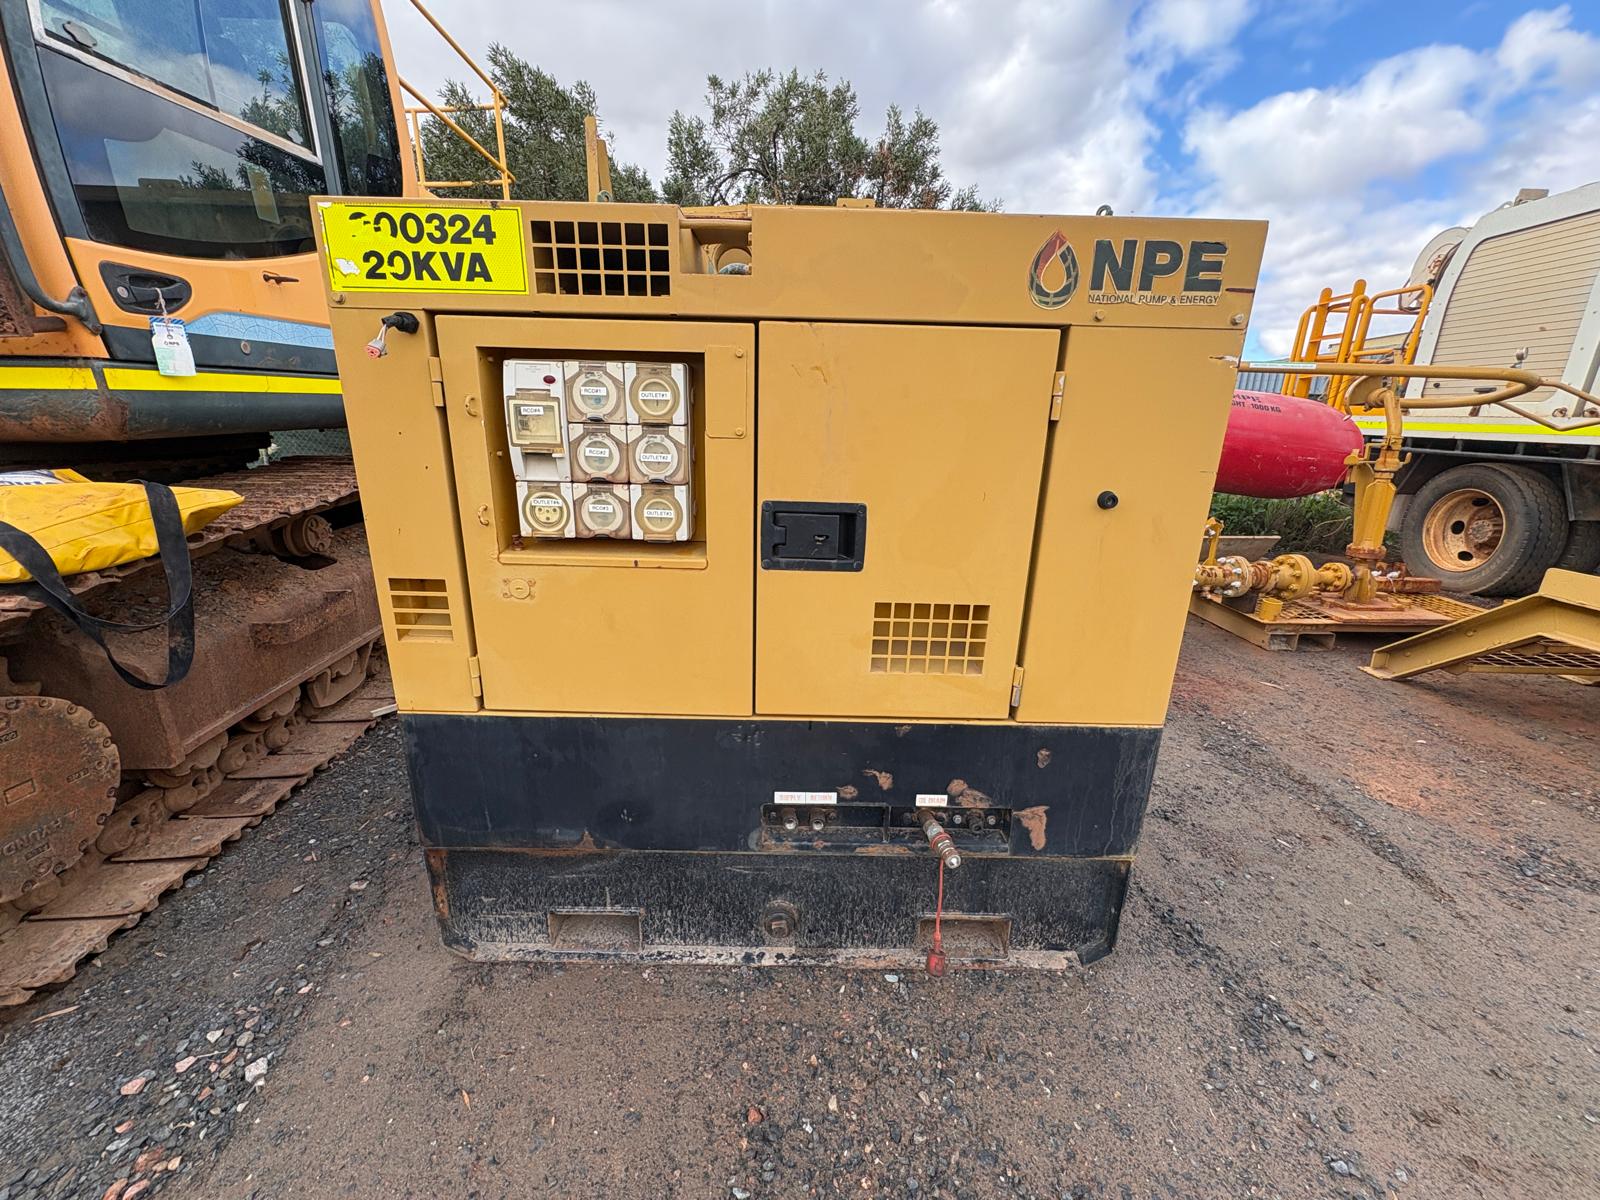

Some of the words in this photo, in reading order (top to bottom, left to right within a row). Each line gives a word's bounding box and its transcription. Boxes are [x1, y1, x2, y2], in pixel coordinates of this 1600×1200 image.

[349, 212, 497, 245] 00324
[362, 250, 493, 282] 20KVA
[1090, 239, 1228, 292] NPE
[1088, 294, 1135, 304] NATIONAL
[1138, 295, 1168, 304] PUMP
[1170, 296, 1177, 304] &
[1179, 295, 1220, 304] ENERGY
